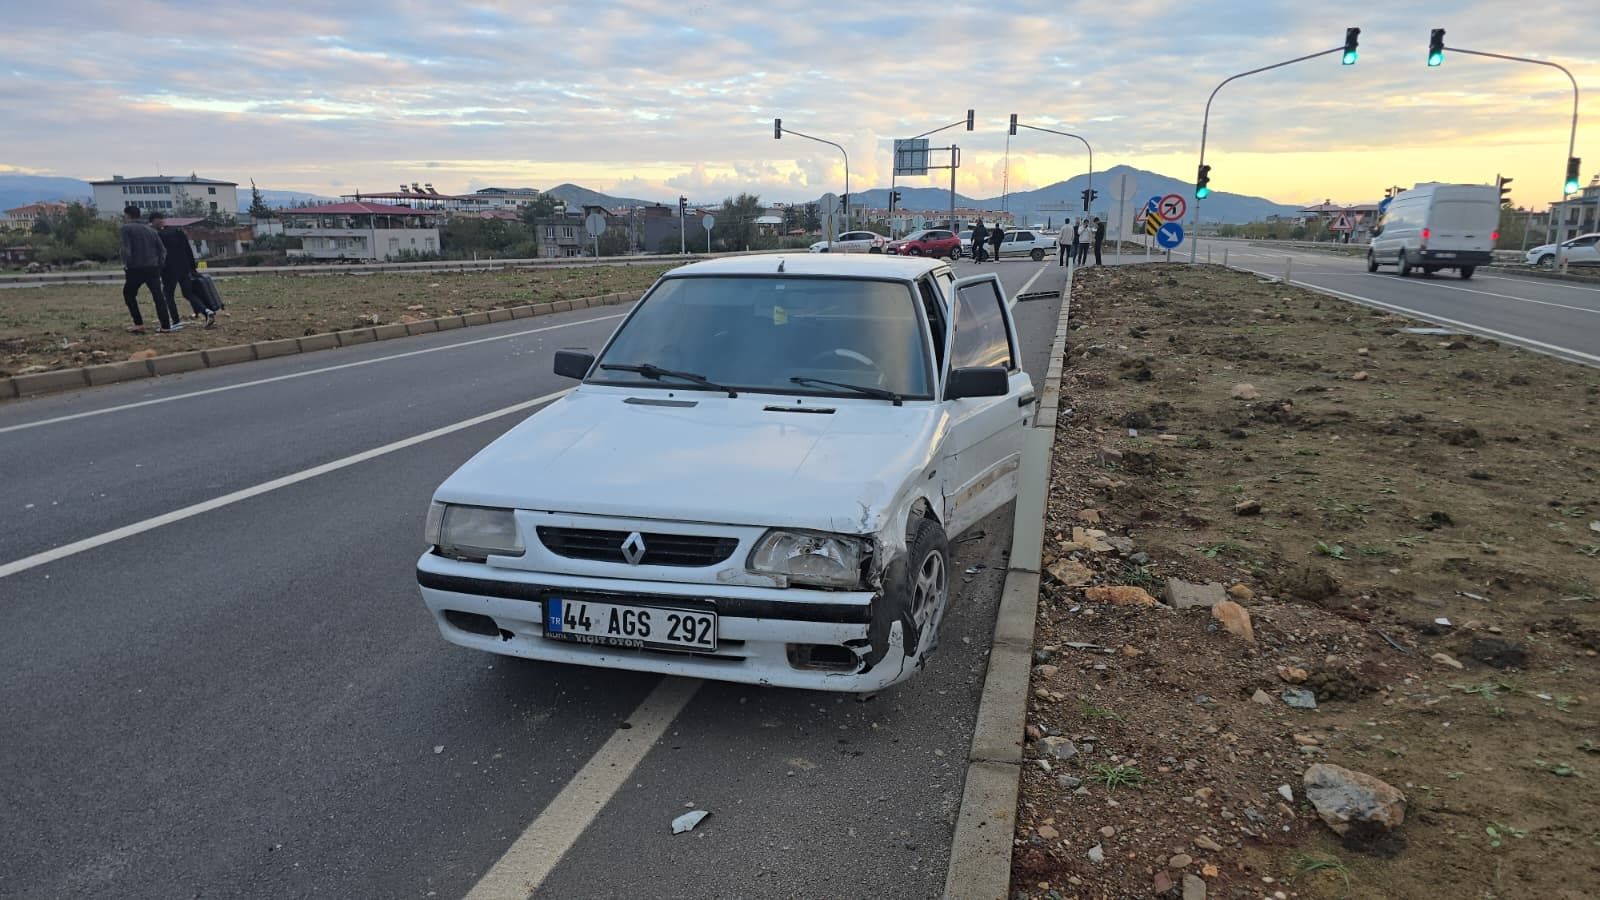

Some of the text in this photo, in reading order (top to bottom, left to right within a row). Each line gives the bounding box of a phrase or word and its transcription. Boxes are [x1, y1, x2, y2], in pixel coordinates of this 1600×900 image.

[550, 616, 561, 625] TR
[563, 602, 712, 645] 44 AGS 292
